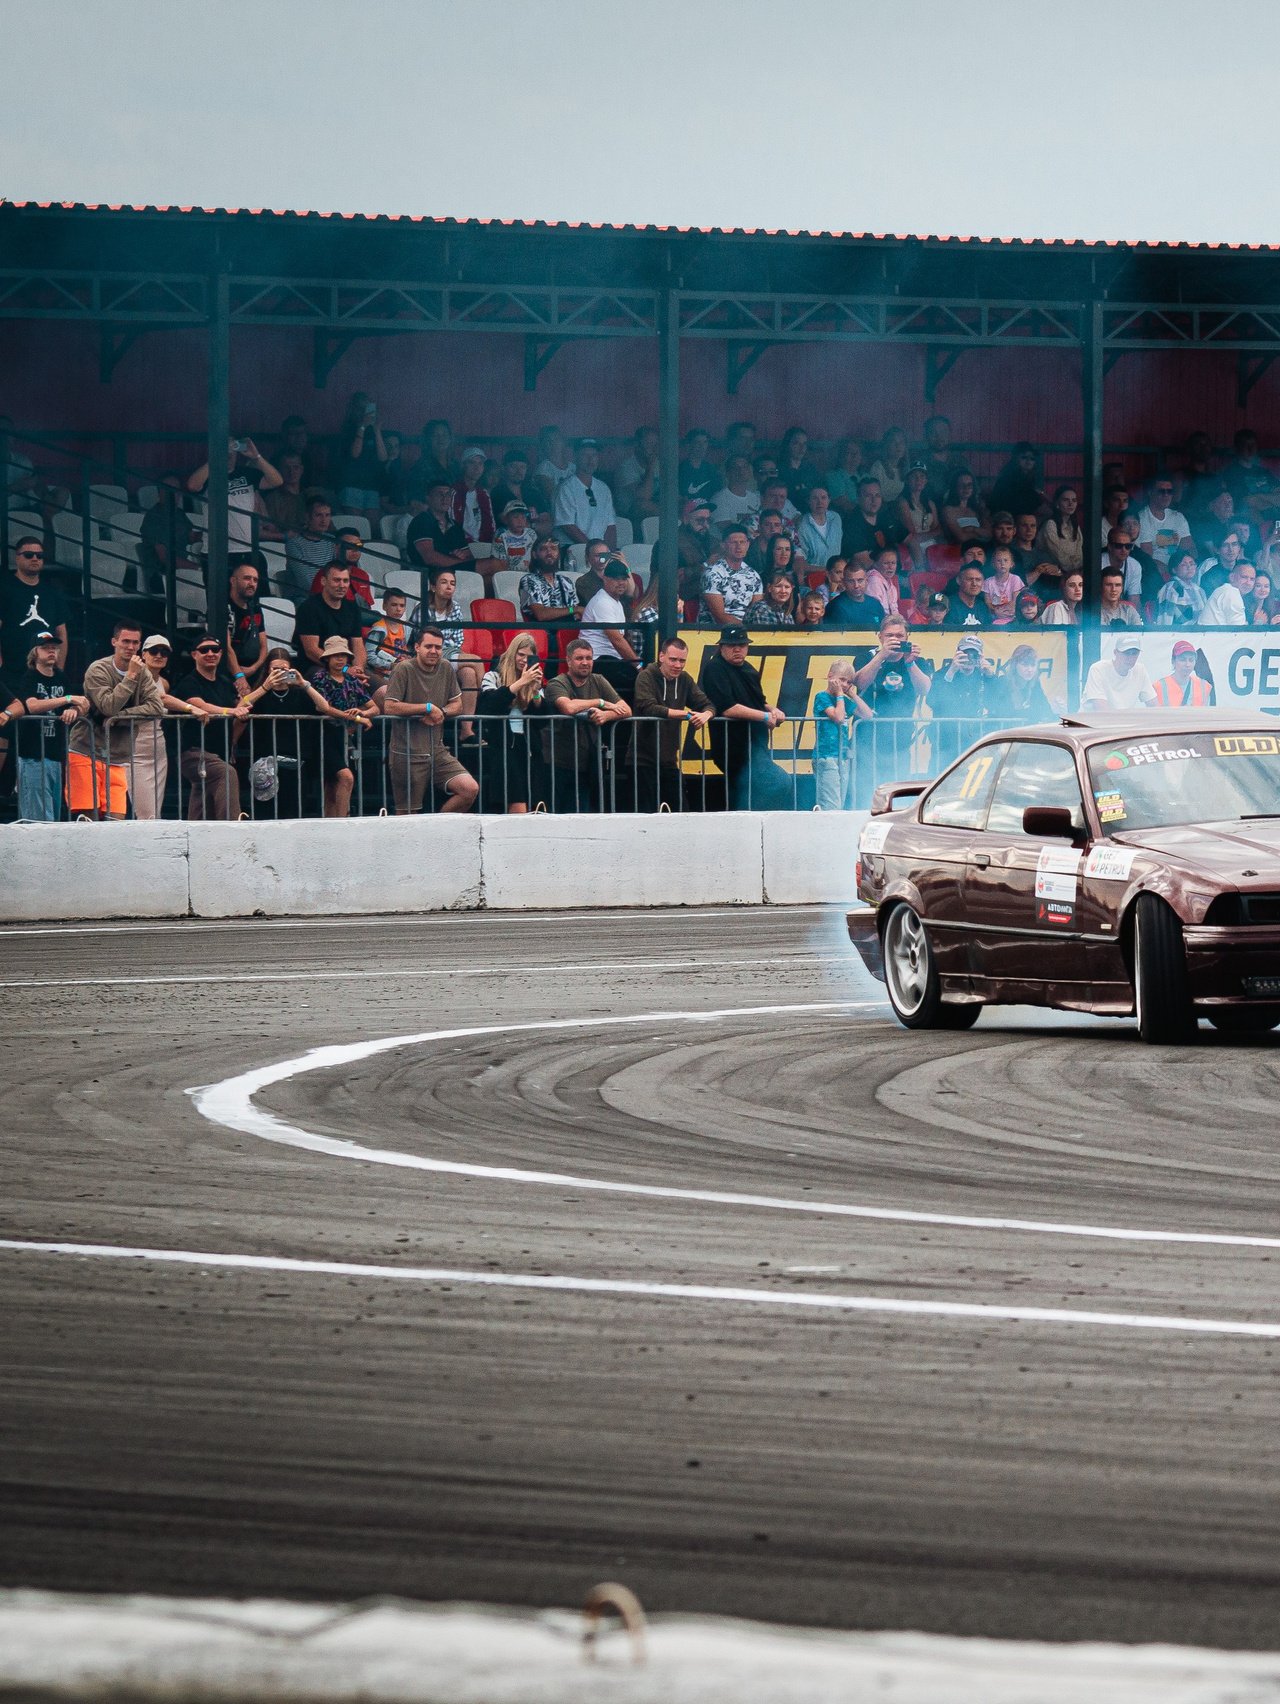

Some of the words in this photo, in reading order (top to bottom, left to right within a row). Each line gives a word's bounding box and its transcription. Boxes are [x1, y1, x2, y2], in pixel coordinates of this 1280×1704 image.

[1126, 742, 1159, 757] GET
[1217, 738, 1276, 754] ULD
[1134, 748, 1202, 766] PETROL
[1099, 863, 1125, 875] PETROL
